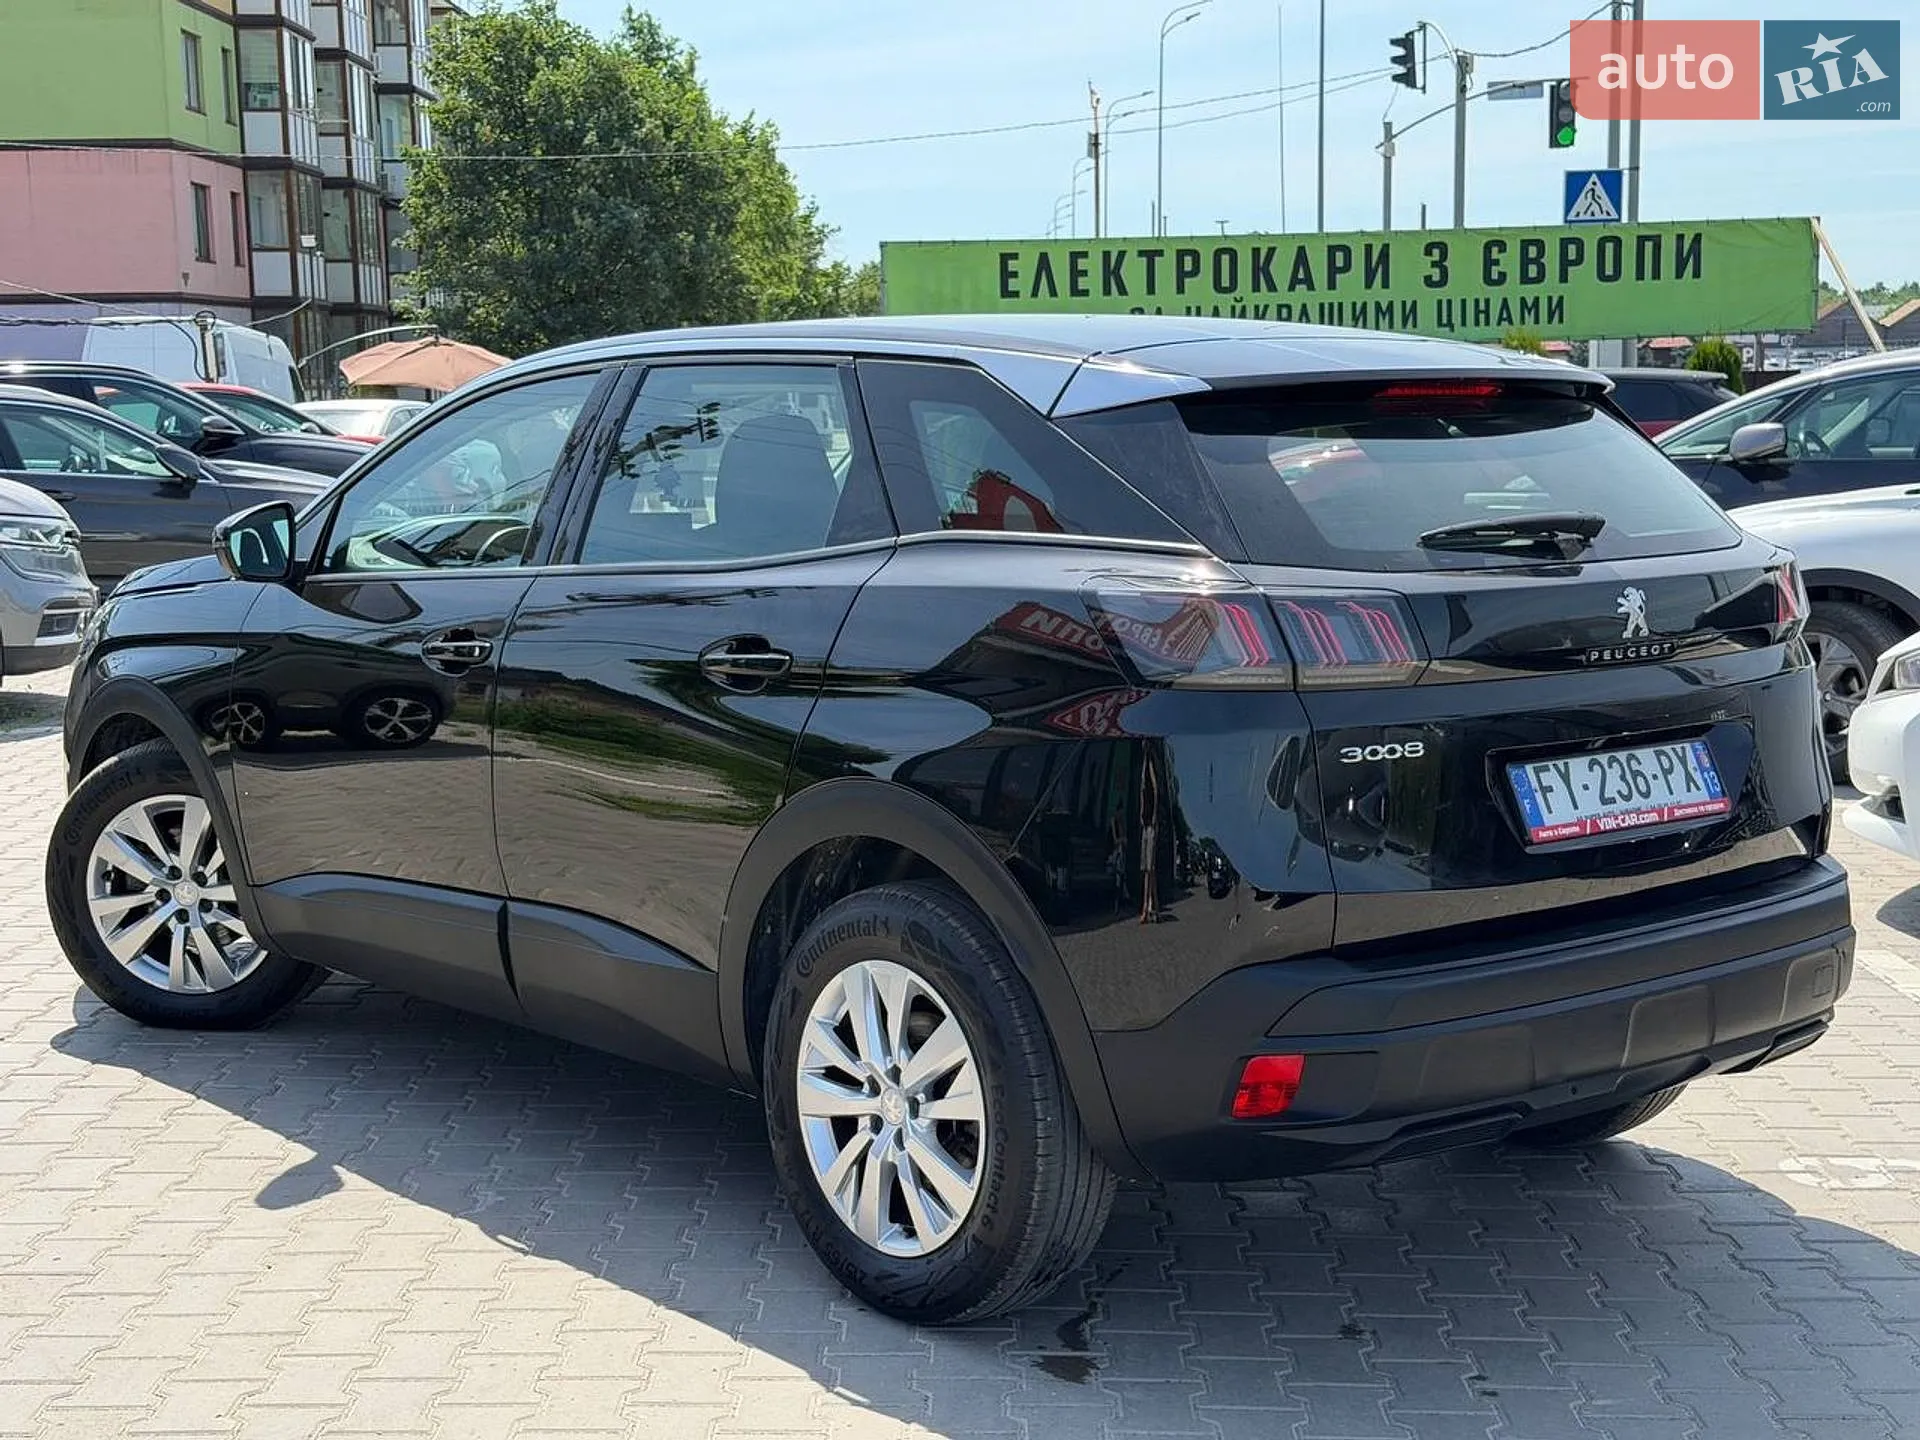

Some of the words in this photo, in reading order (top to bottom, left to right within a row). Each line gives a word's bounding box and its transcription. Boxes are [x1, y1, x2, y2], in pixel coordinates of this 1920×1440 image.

[999, 243, 1391, 298] ЕЛЕКТРОКАРИ
[1482, 233, 1703, 287] ЄВРОПИ
[1436, 296, 1565, 331] ЦІНАМИ
[1590, 643, 1673, 662] PEUGEOT
[1339, 742, 1425, 763] 3008
[1533, 745, 1702, 814] FY-236-PX
[1702, 771, 1722, 793] 13
[796, 914, 878, 978] Continental
